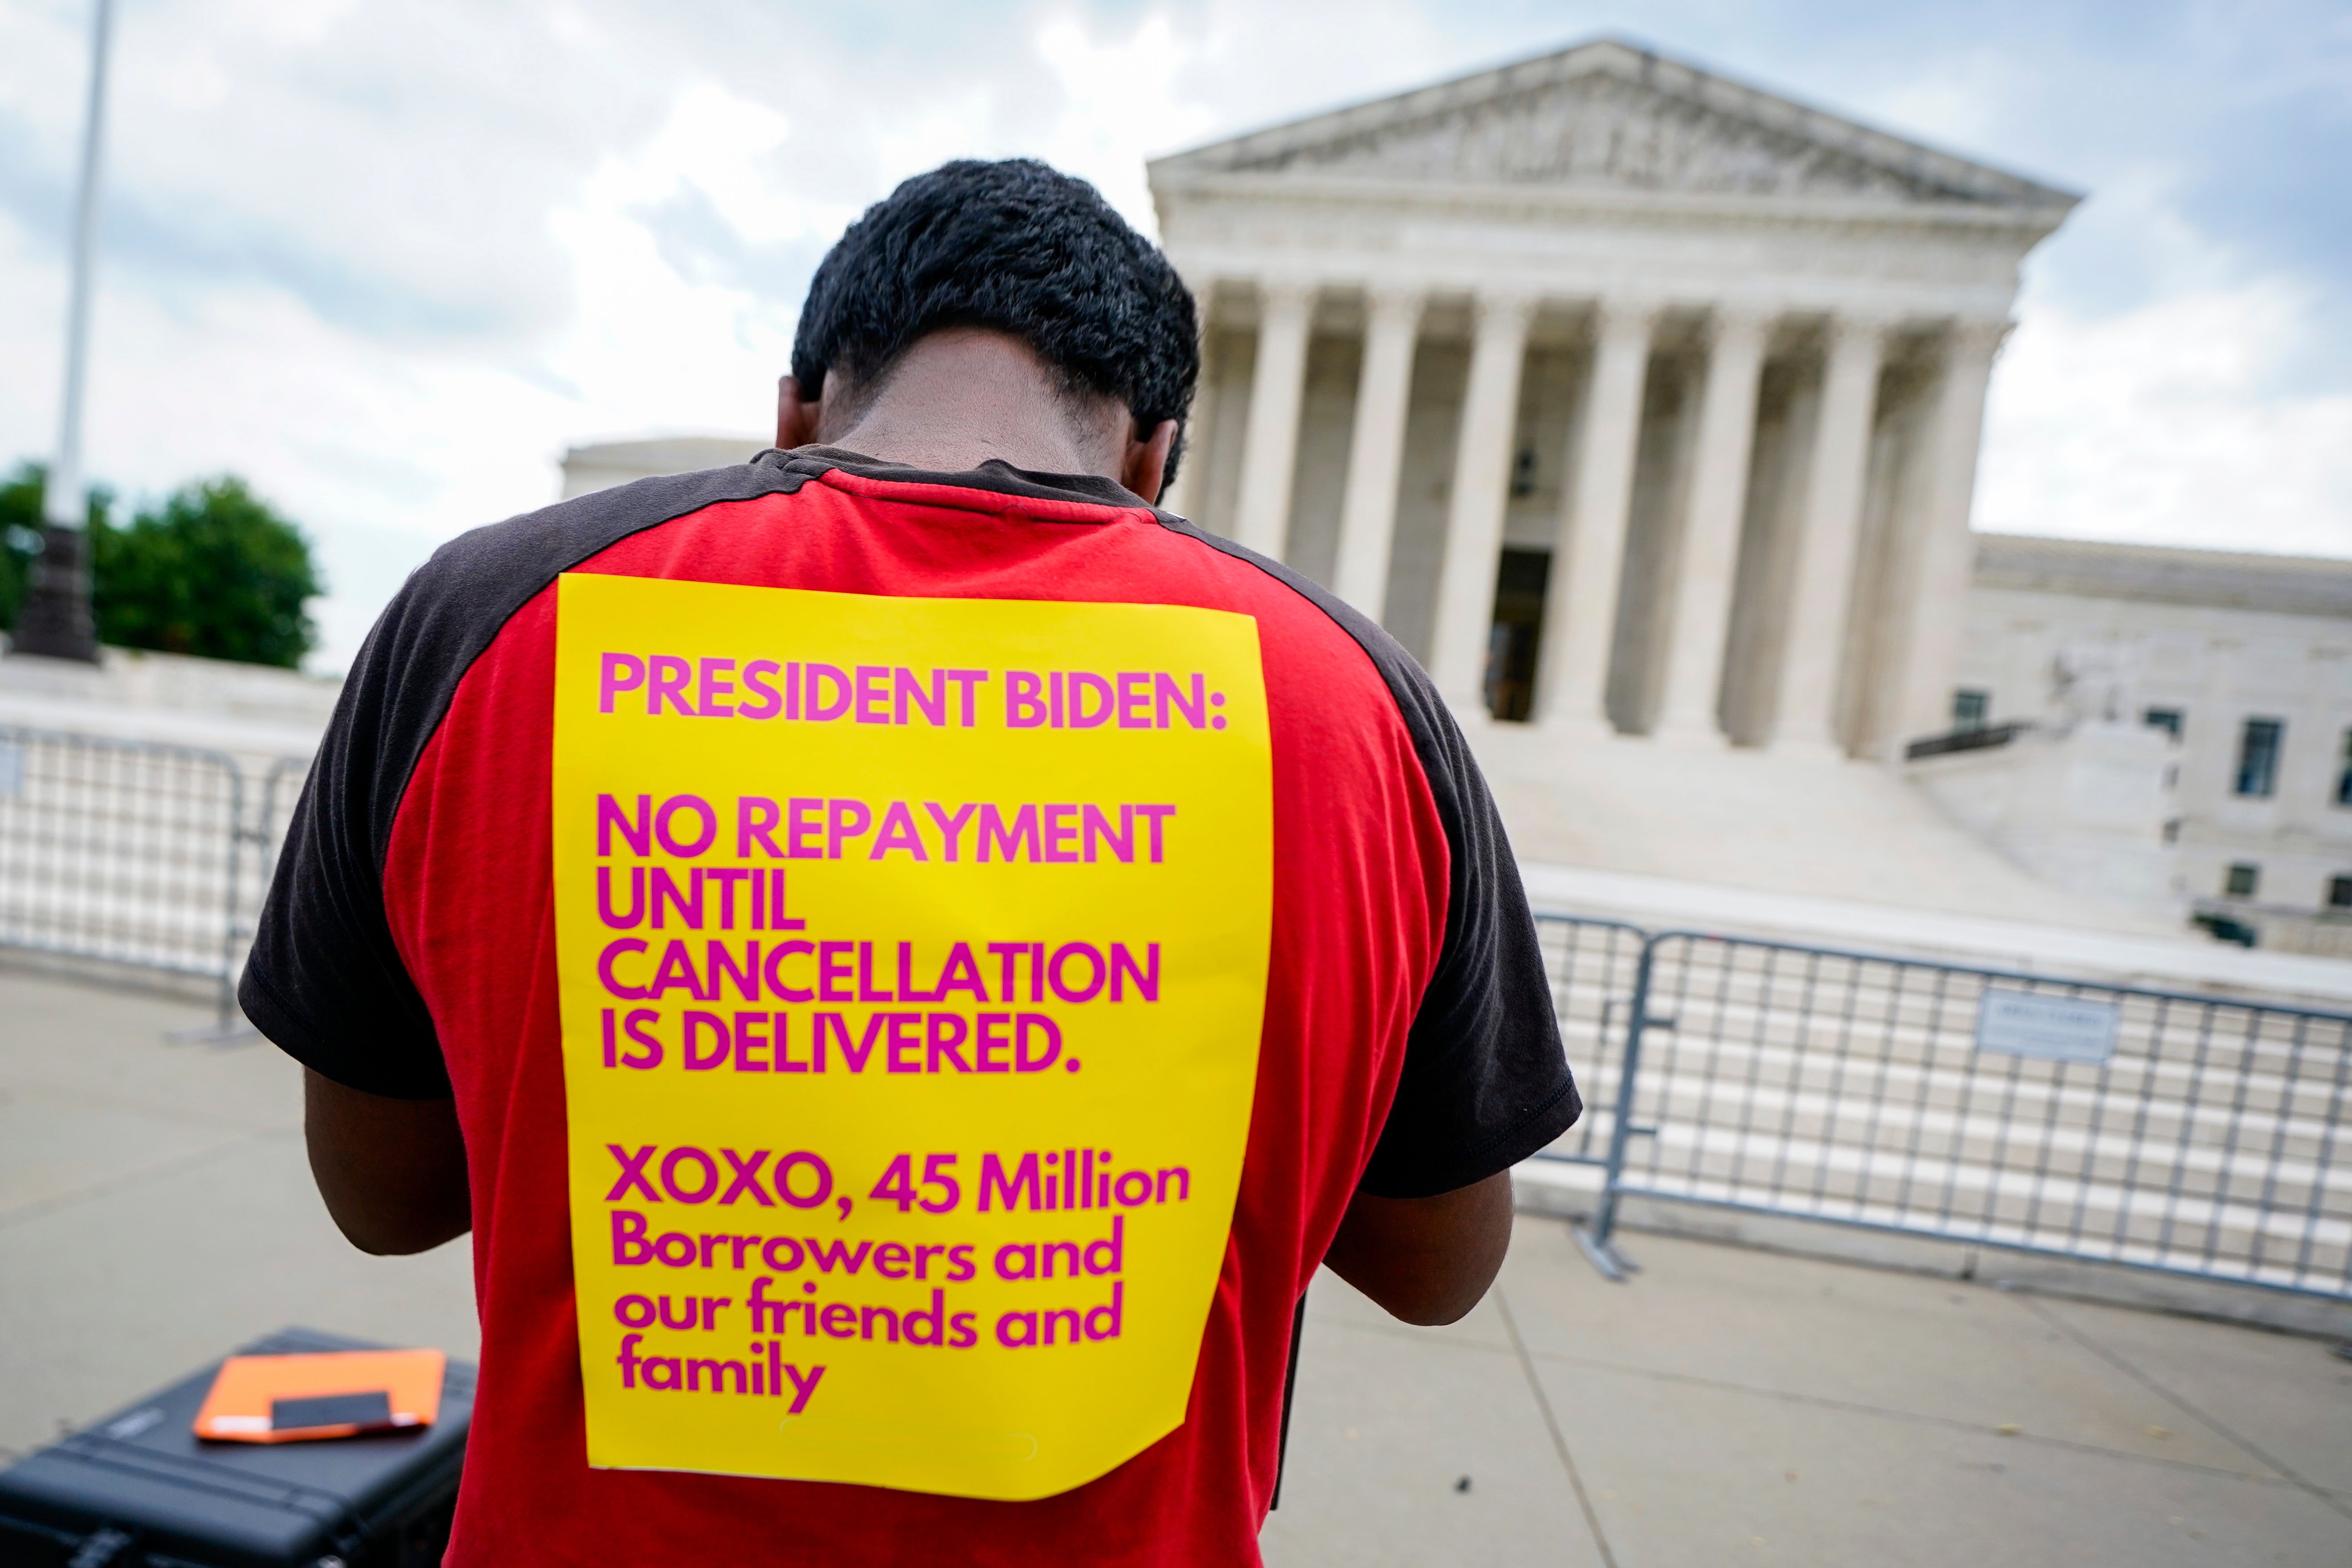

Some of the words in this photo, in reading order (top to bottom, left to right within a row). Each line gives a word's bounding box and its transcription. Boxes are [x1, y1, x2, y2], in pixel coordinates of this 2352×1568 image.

[600, 653, 987, 727] PRESIDENT
[1006, 671, 1226, 730] BIDEN:
[598, 794, 717, 858] NO
[738, 797, 1176, 862] REPAYMENT
[597, 867, 805, 930] UNTIL
[598, 938, 1160, 1003] CANCELLATION
[602, 1009, 663, 1070] IS
[684, 1011, 1080, 1073] DELIVERED.
[606, 1145, 852, 1220] XOXO,
[870, 1155, 960, 1213] 45
[978, 1150, 1189, 1212] Million
[612, 1211, 976, 1281] Borrowers
[994, 1216, 1123, 1280] and
[615, 1295, 731, 1330] our
[747, 1278, 977, 1348] friends
[996, 1282, 1123, 1348] and
[617, 1335, 825, 1413] family
